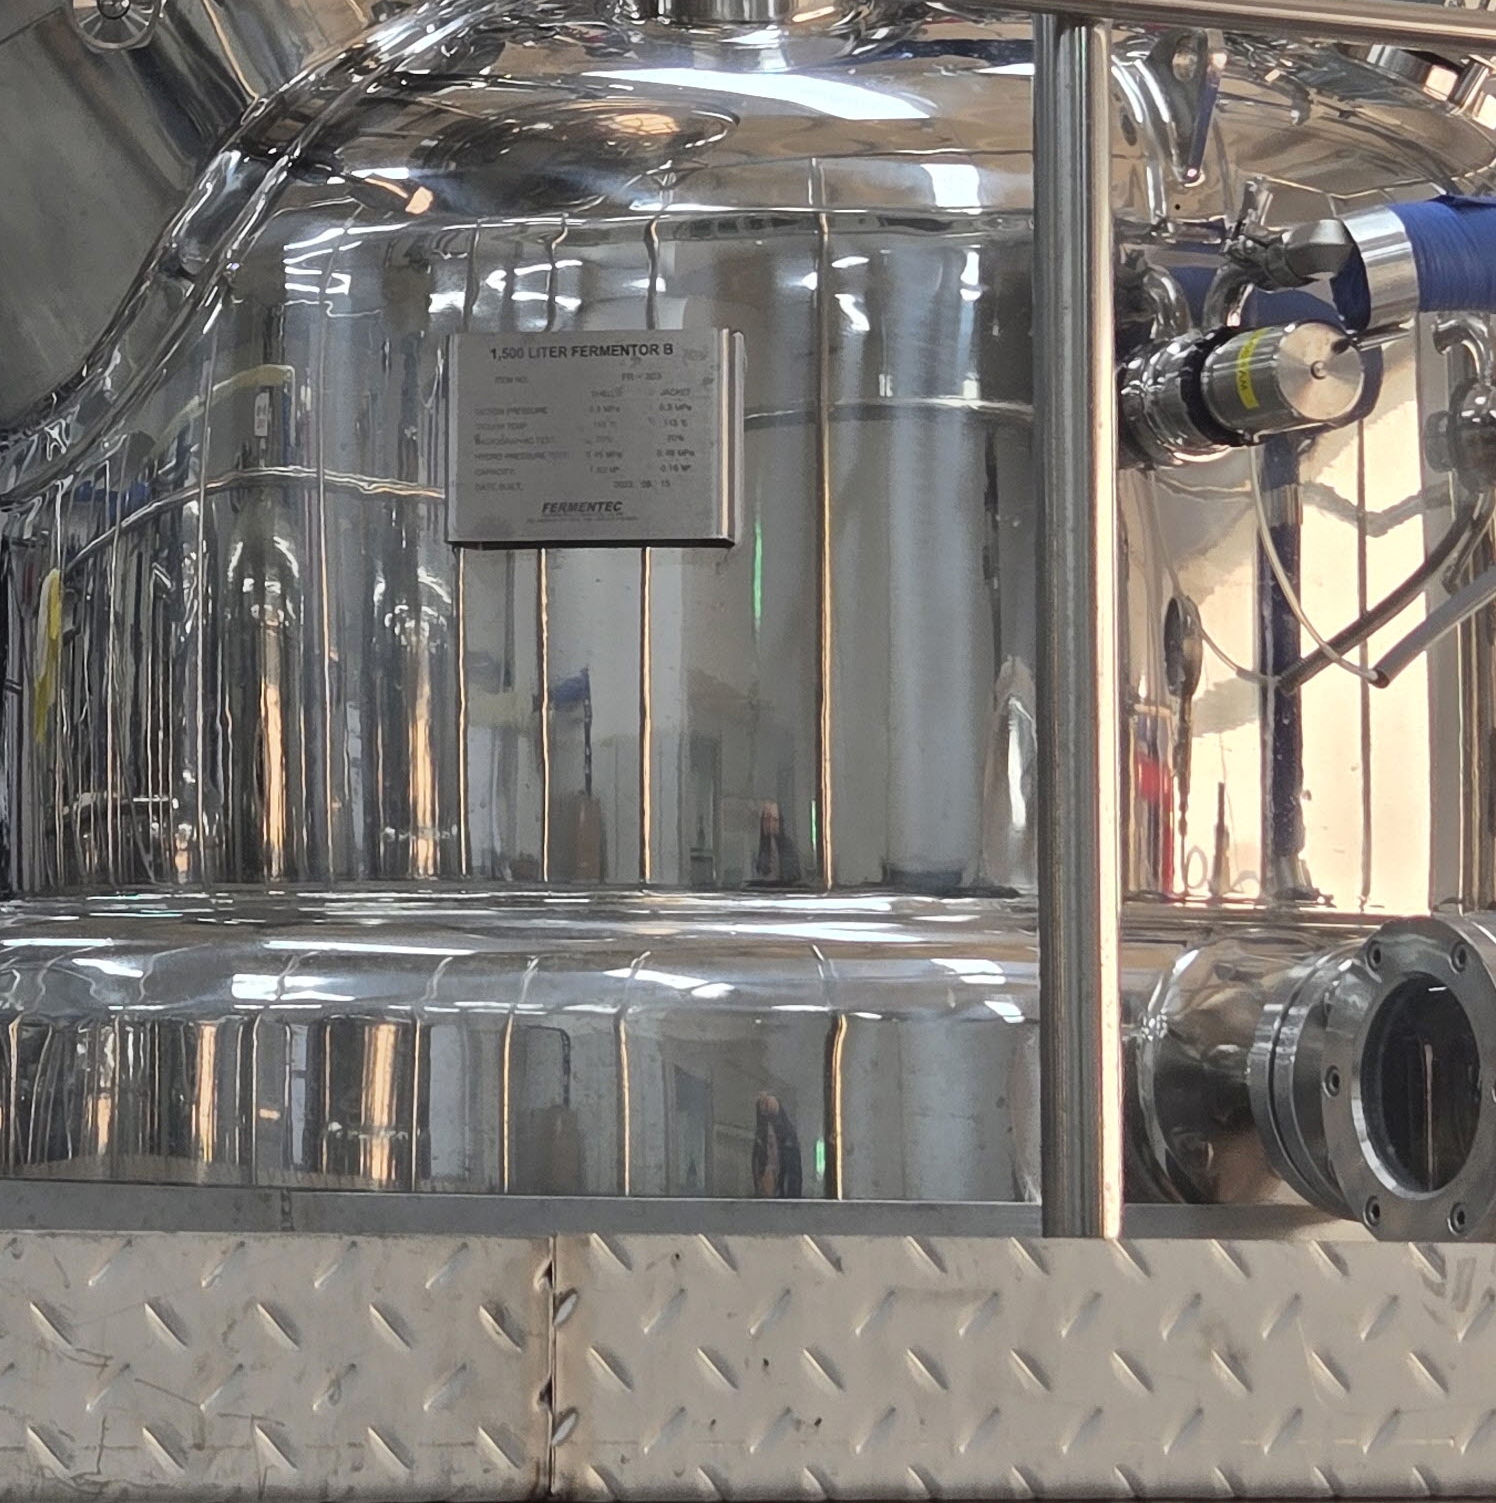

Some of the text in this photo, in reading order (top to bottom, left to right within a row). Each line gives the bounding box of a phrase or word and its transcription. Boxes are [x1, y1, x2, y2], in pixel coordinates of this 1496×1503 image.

[490, 343, 674, 361] 1,500 LITER FERMENTOR B
[541, 500, 623, 513] FERMENTEC
